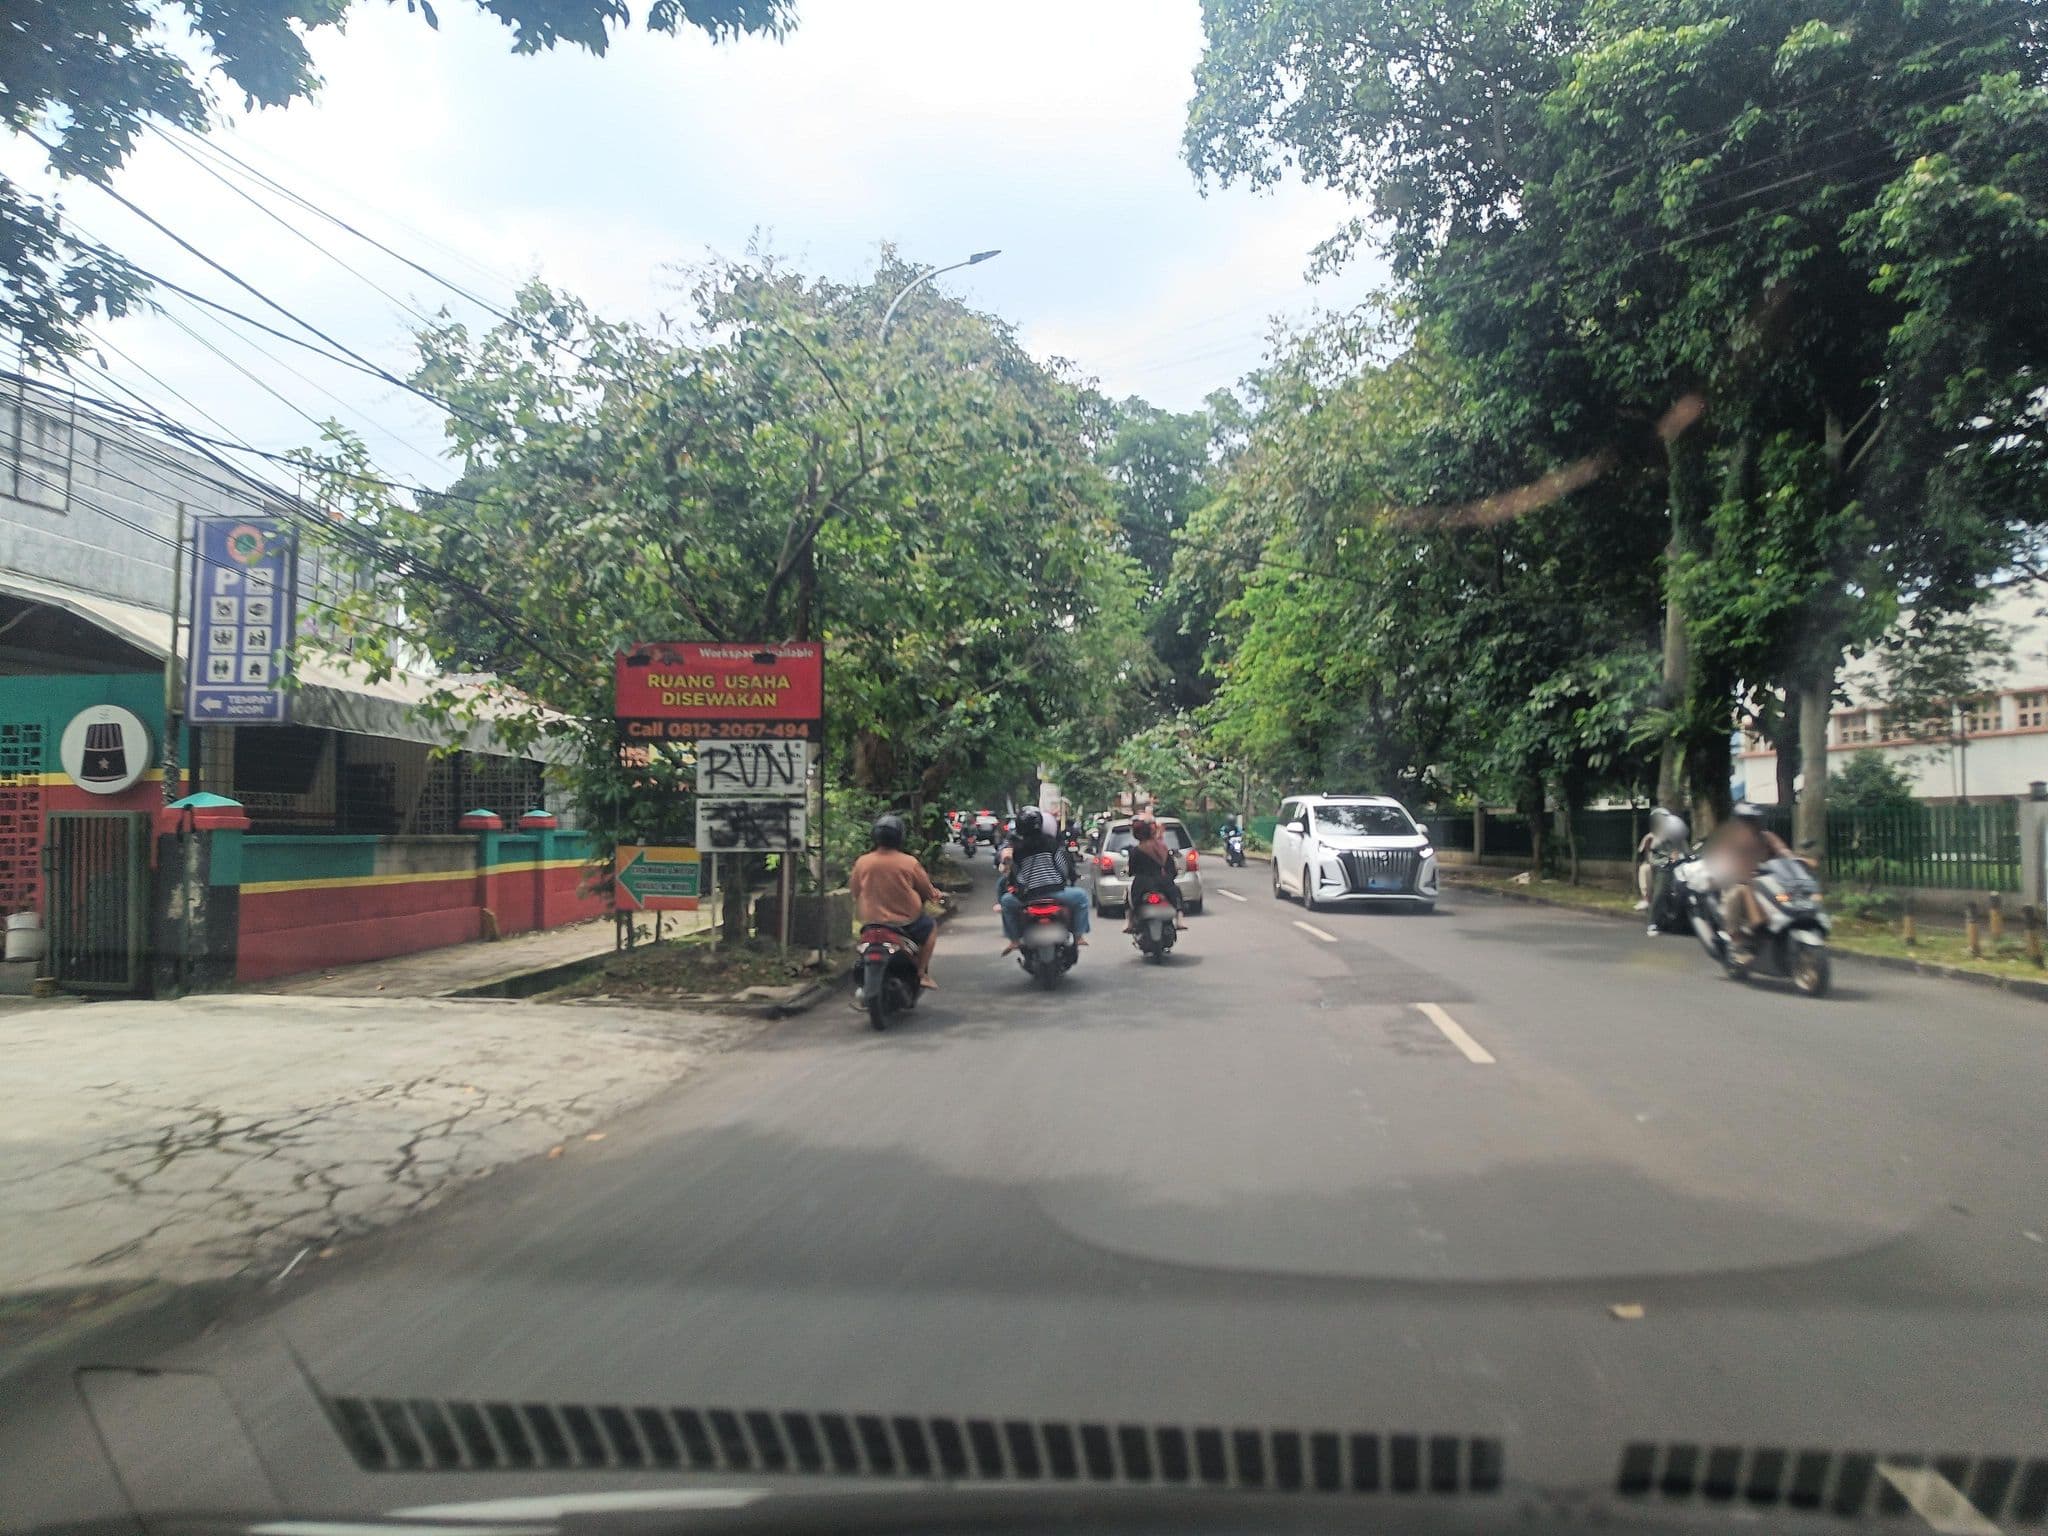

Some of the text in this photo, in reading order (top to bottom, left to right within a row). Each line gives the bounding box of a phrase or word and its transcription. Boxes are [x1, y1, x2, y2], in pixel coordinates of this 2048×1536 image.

[215, 567, 240, 594] P
[647, 674, 791, 689] RUANG USAHA
[227, 695, 273, 704] TEMPAT
[662, 692, 777, 706] DISEWAKAN
[628, 722, 664, 737] Call
[700, 741, 794, 789] RUN
